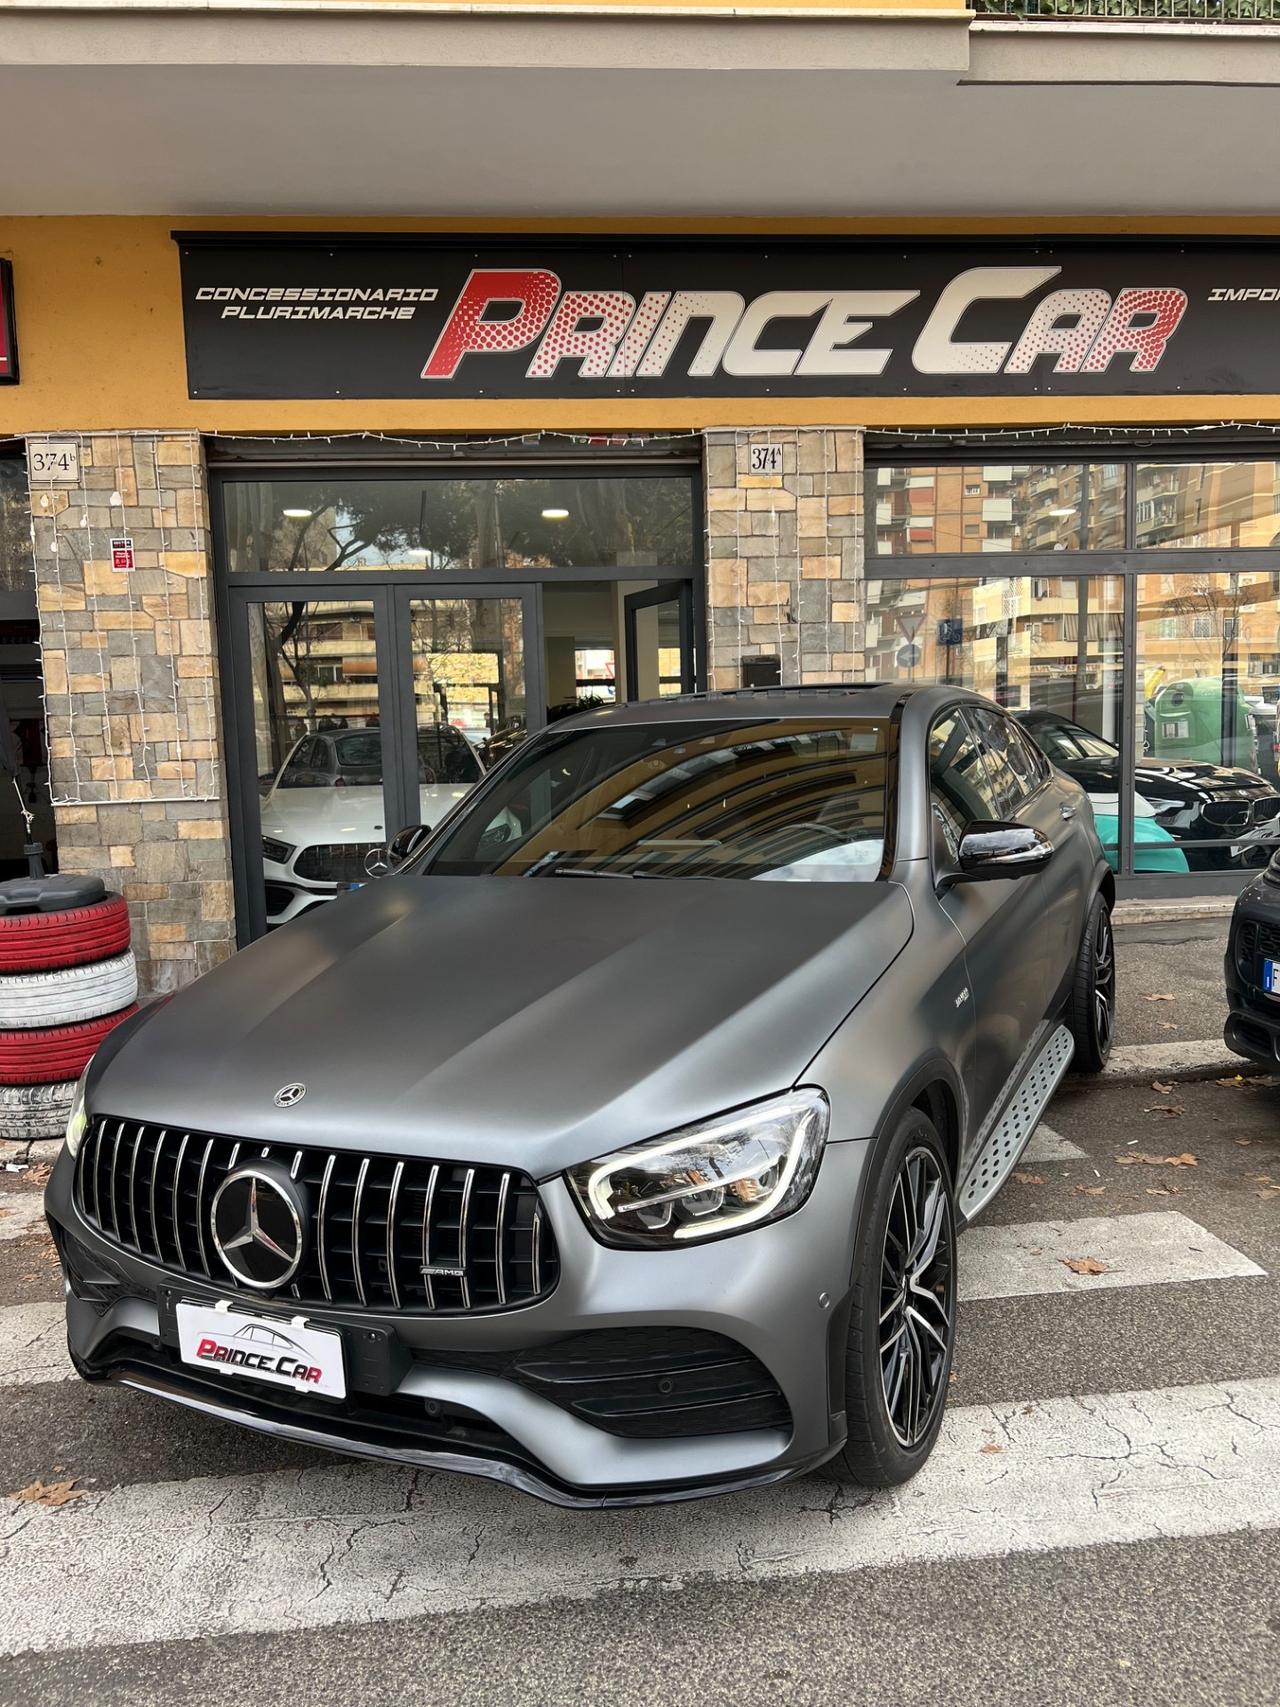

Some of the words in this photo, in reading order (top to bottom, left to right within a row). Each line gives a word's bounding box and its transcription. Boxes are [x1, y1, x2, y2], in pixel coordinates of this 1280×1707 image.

[195, 287, 439, 301] CONCESSIONARIO
[1208, 288, 1280, 301] IMPO
[220, 306, 416, 319] PLURIMARCHE
[420, 268, 920, 379] PRINCE
[911, 266, 1189, 375] CAR
